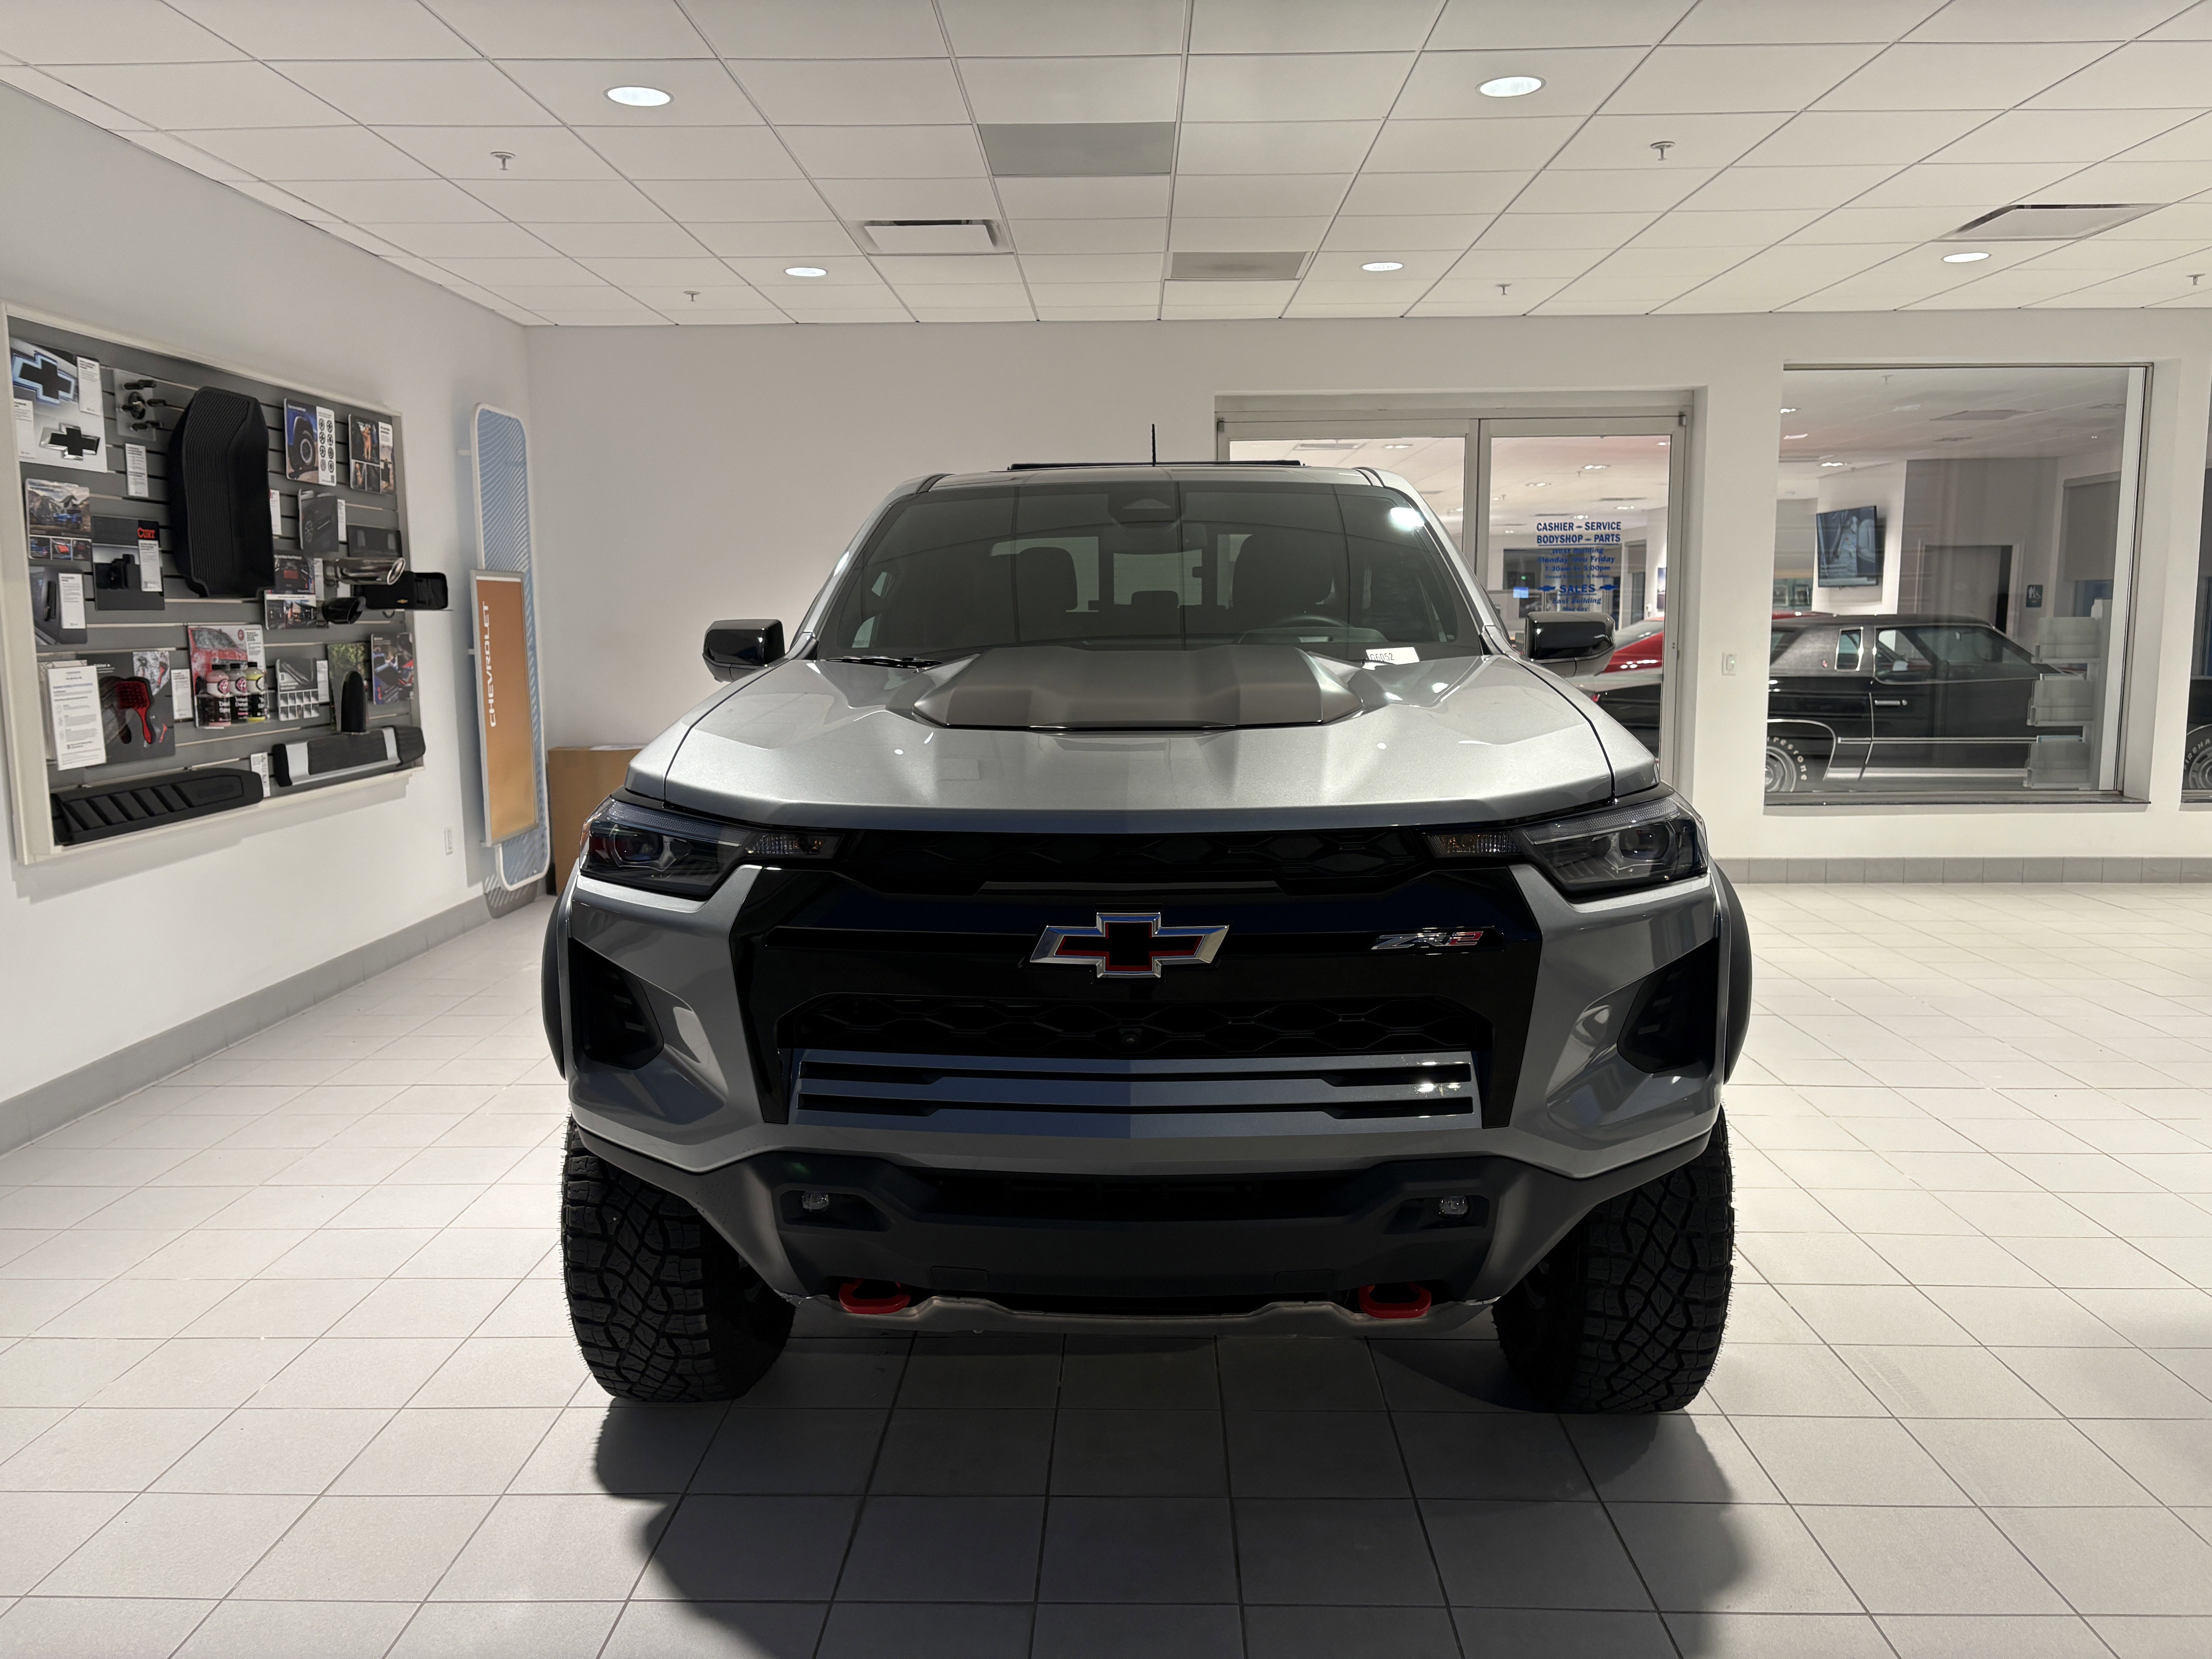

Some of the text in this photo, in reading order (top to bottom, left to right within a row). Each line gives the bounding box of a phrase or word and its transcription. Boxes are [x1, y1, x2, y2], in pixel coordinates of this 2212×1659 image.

[1537, 522, 1621, 531] CASHIER SERVICE
[1537, 534, 1621, 543] BODYSHOP PARTS
[1559, 584, 1595, 593] SALES
[1370, 653, 1395, 661] G6052
[482, 601, 496, 727] CHEVROLET
[1767, 737, 1807, 780] irestone
[1371, 931, 1484, 950] ZR2
